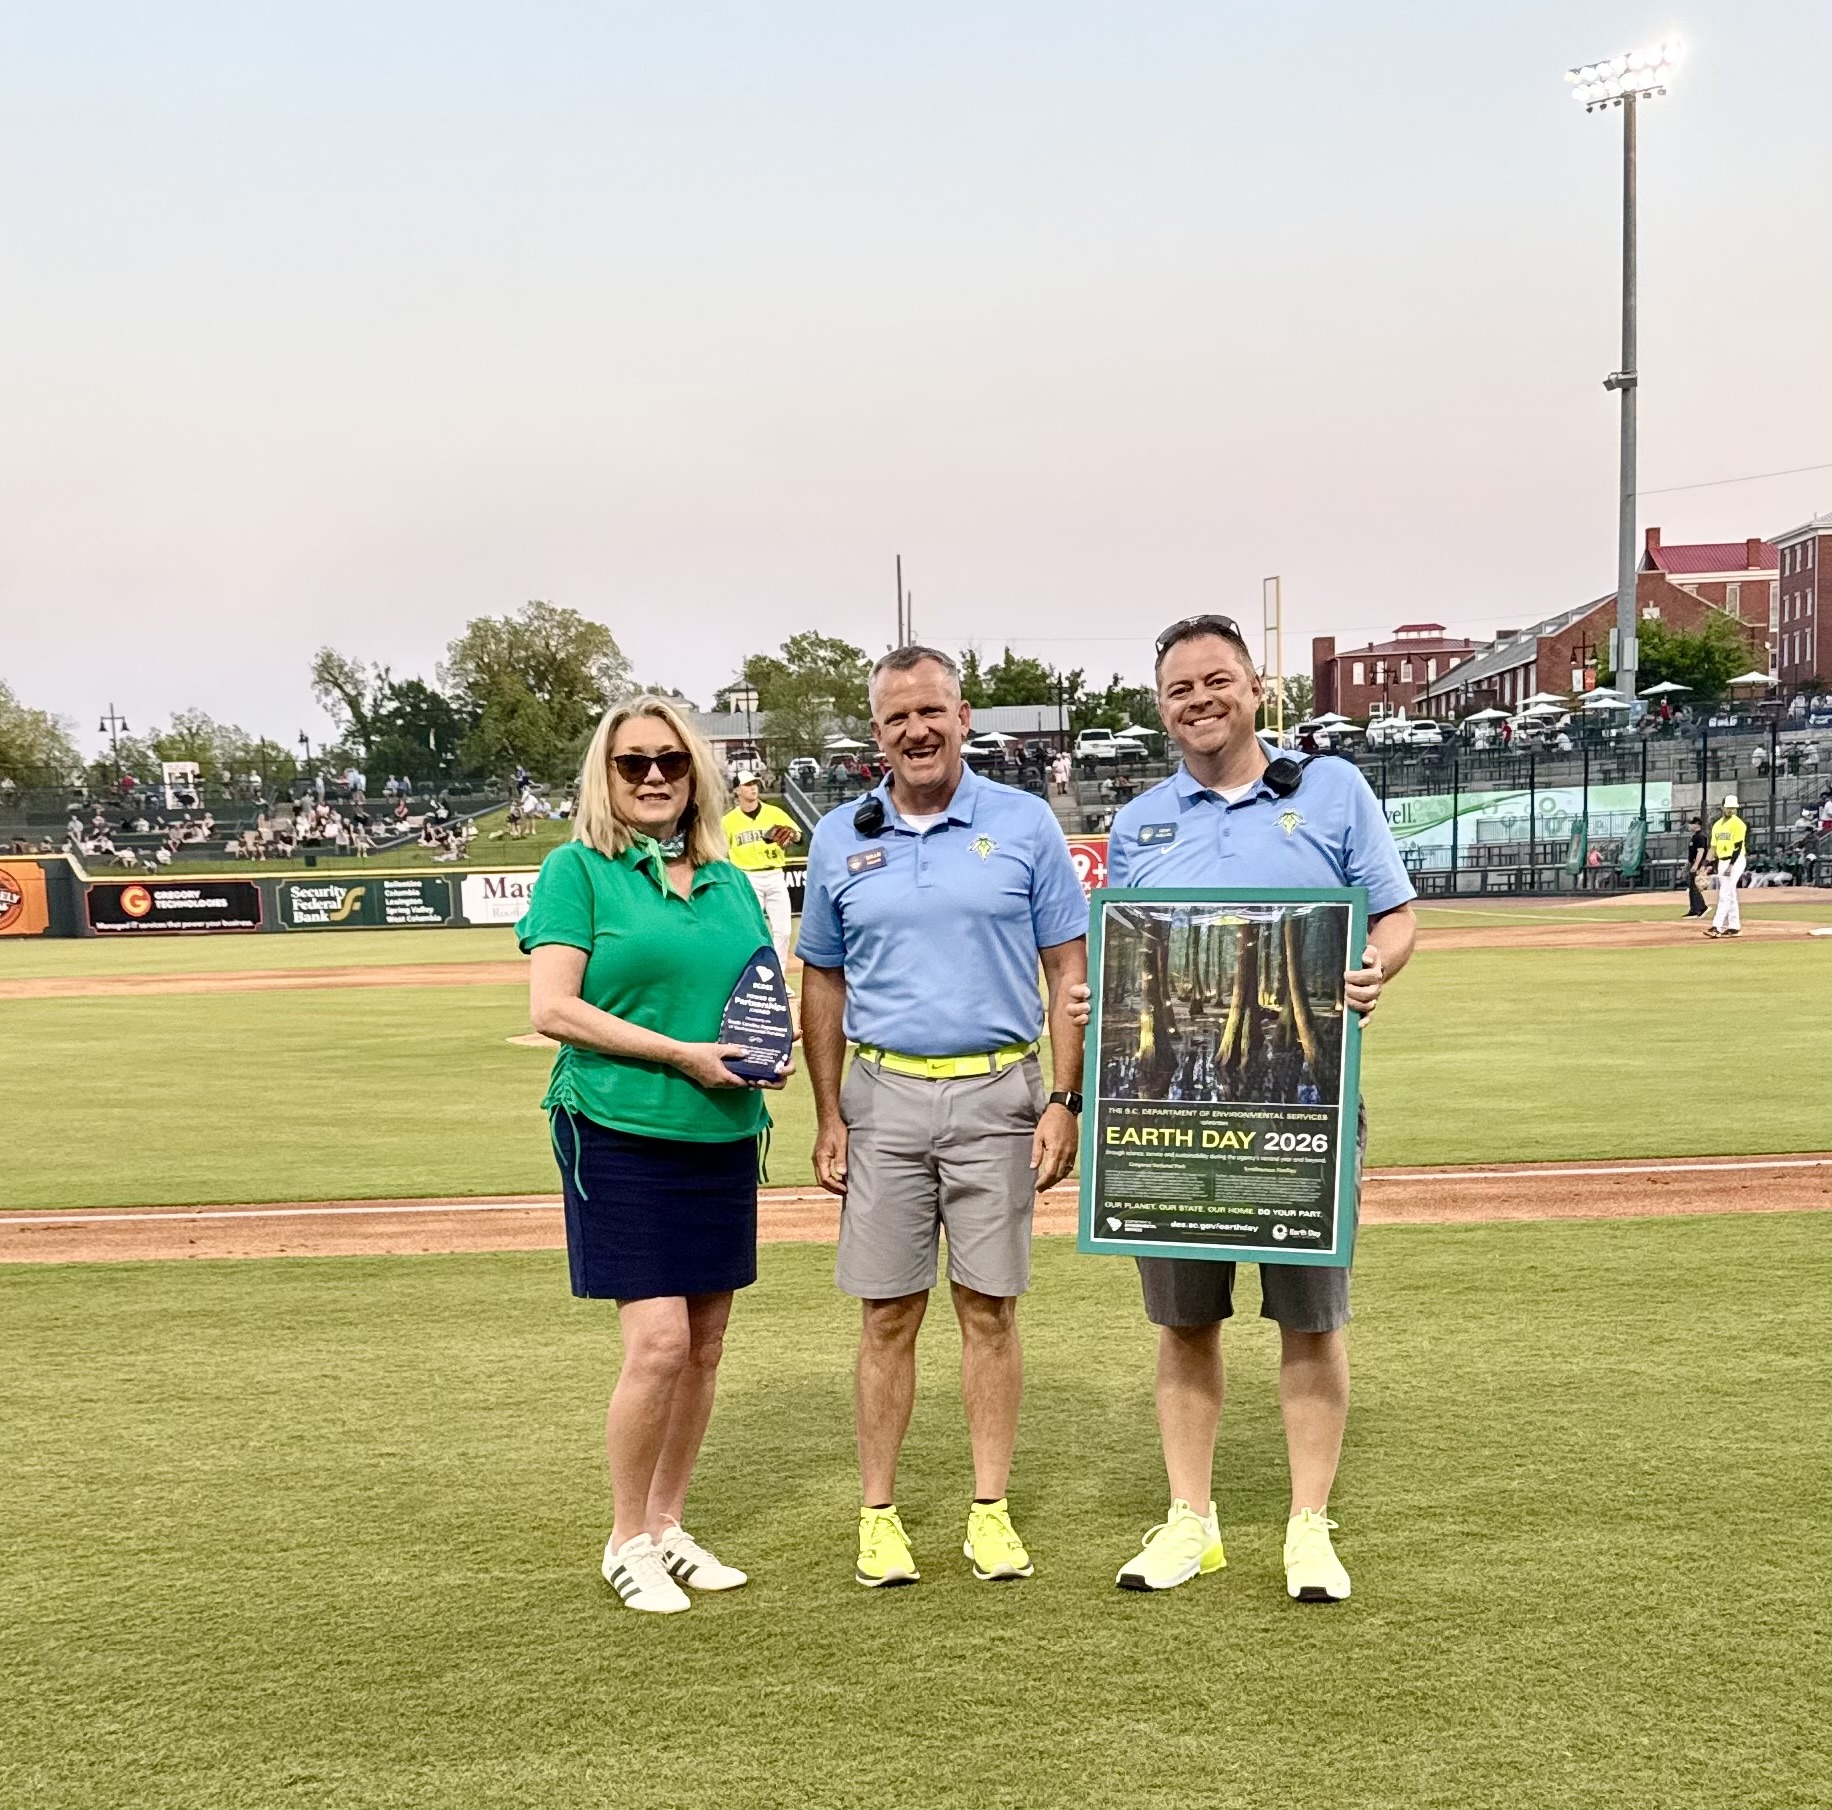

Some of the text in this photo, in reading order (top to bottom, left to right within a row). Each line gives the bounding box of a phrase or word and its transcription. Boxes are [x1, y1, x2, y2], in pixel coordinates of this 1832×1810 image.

[153, 890, 201, 899] GREGORY
[290, 885, 347, 899] Security
[384, 889, 421, 897] Columbia
[154, 899, 228, 909] TECHNOLOGIES
[291, 897, 342, 911] Federal
[293, 911, 330, 923] Bank
[406, 914, 442, 923] Columbia
[1108, 1107, 1123, 1115] THE
[1142, 1108, 1197, 1117] DEPARTMENT
[1212, 1110, 1285, 1120] ENVIRONMENTAL
[1286, 1113, 1328, 1121] SERVICES
[1106, 1126, 1328, 1153] EARTH DAY 2026
[1104, 1201, 1122, 1209] OUR
[1158, 1203, 1177, 1211] OUR
[1178, 1205, 1205, 1213] STATE.
[1207, 1206, 1226, 1214] OUR
[1228, 1207, 1256, 1215] HOME.
[1257, 1208, 1271, 1216] DO
[1272, 1209, 1297, 1217] YOUR
[1298, 1210, 1323, 1218] PART.
[1170, 1220, 1259, 1233] des.sc.gov/earthday
[1289, 1228, 1307, 1236] Earth
[1308, 1229, 1321, 1238] Day
